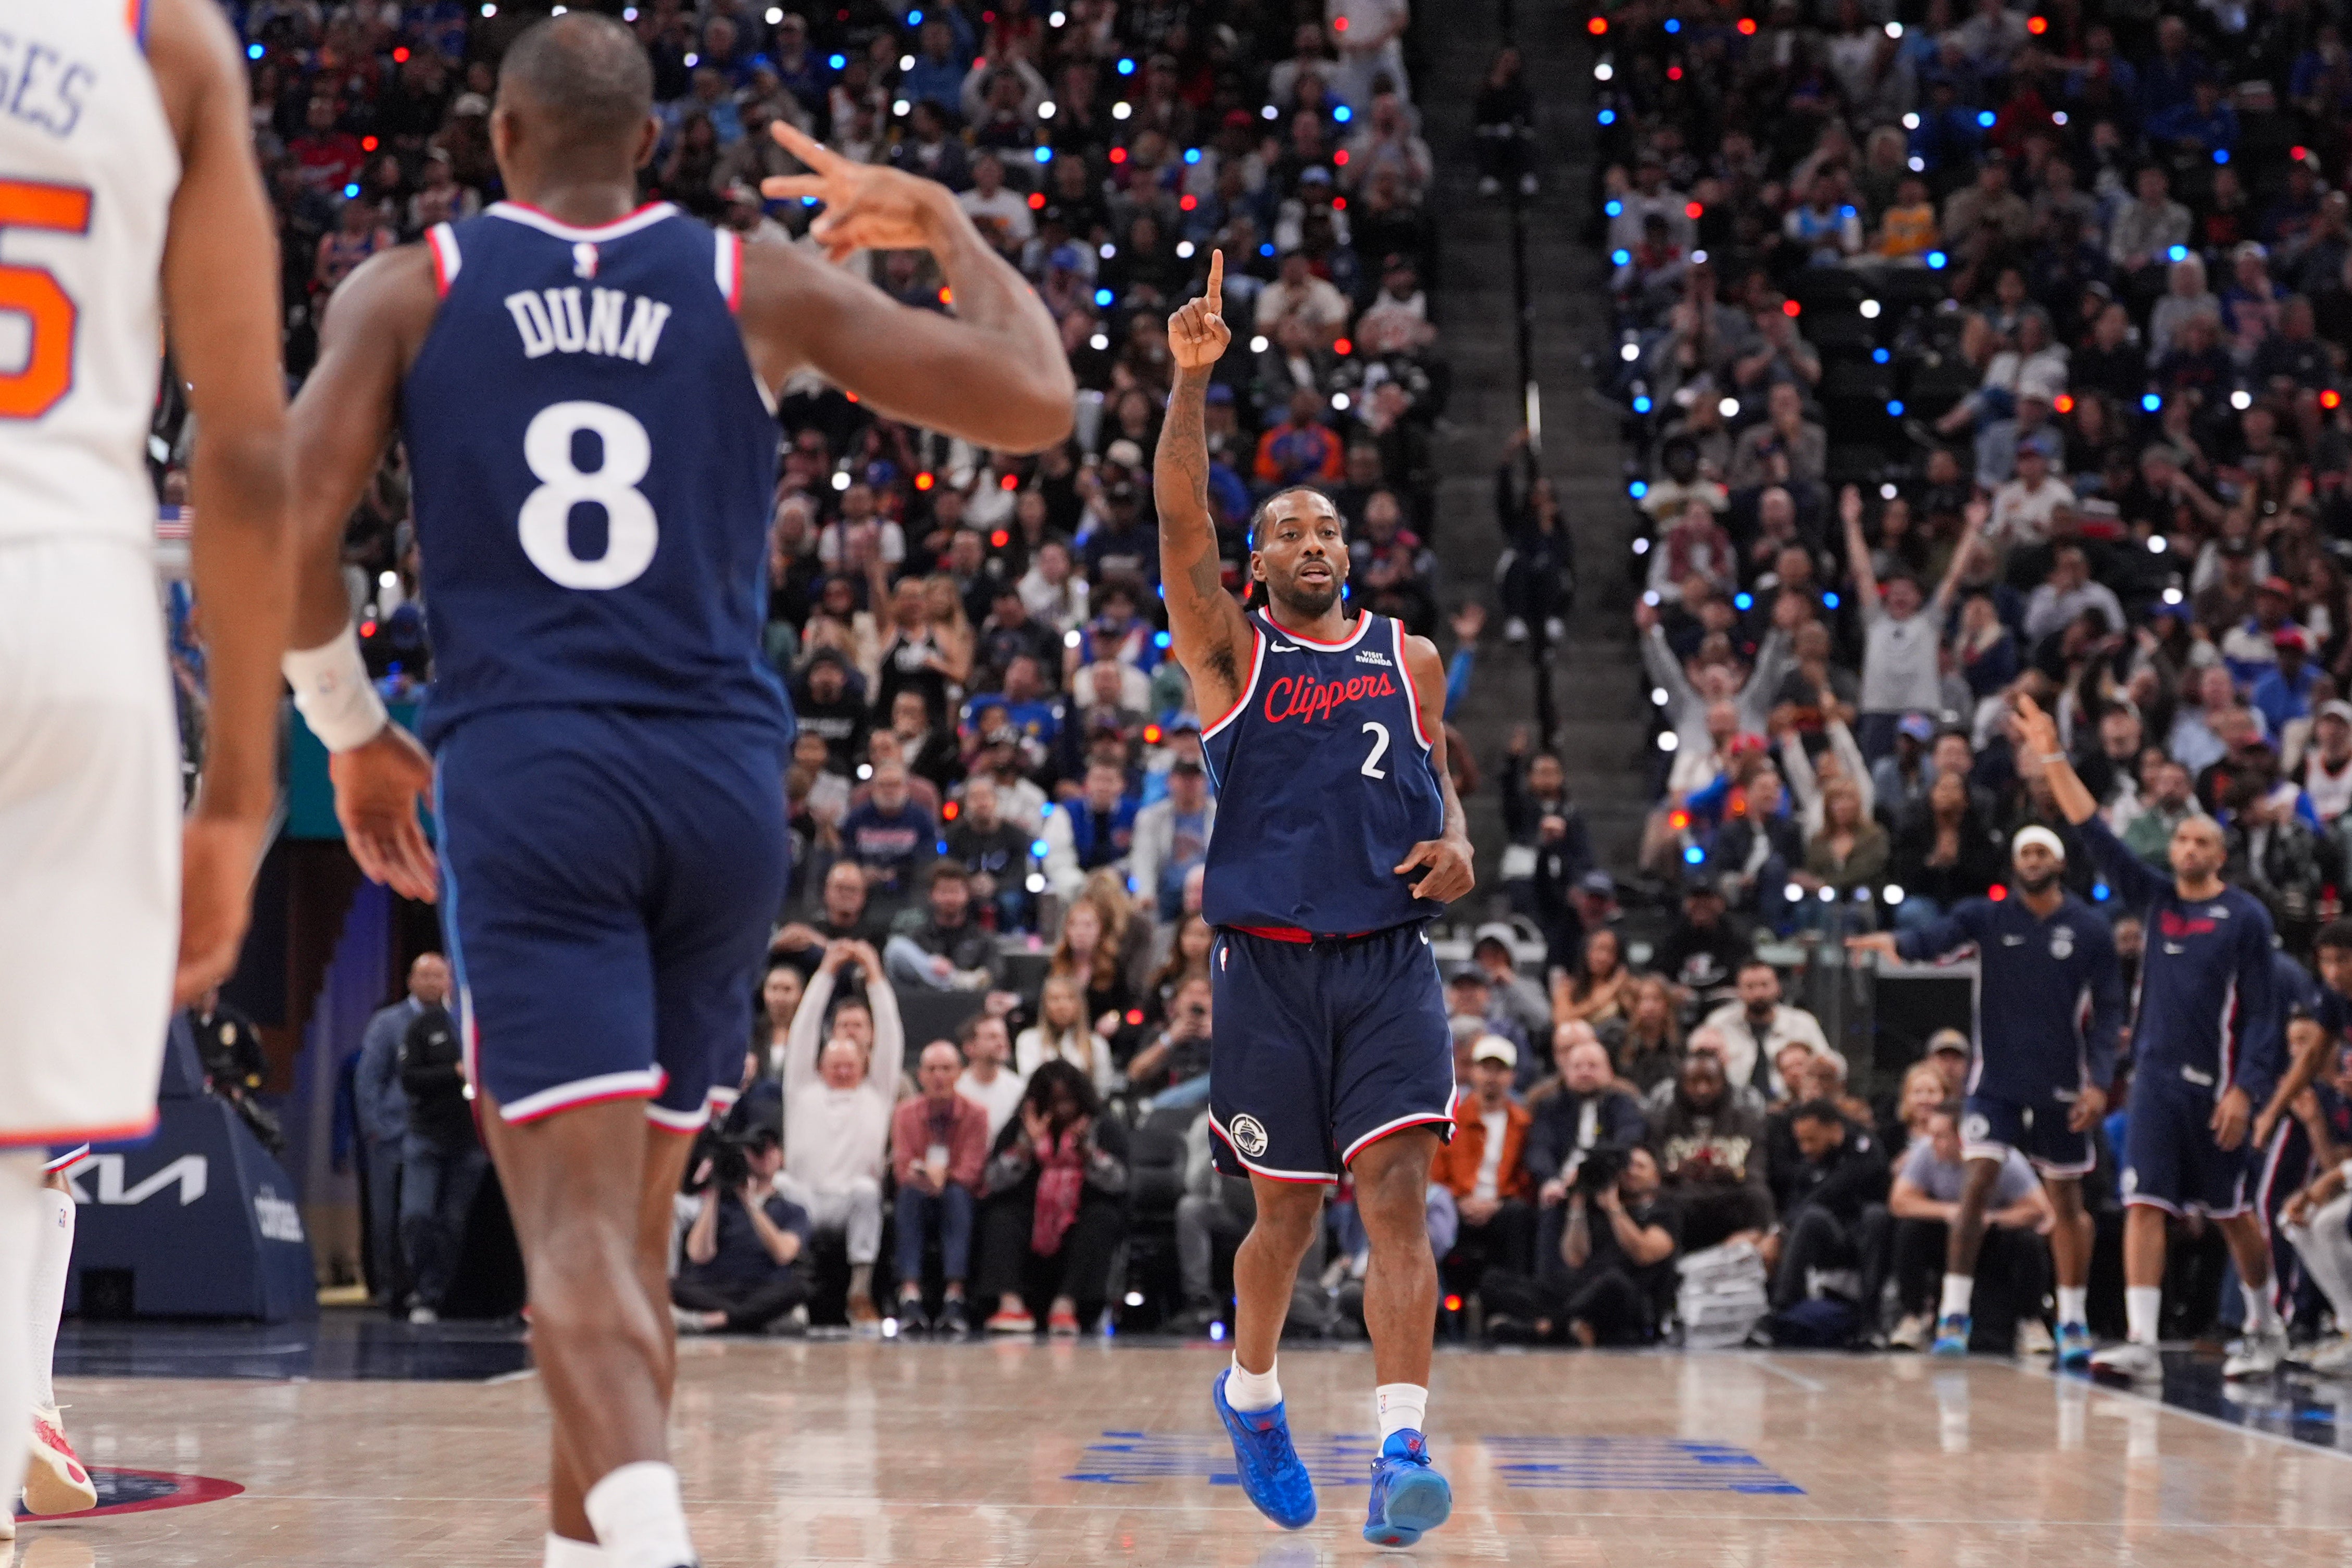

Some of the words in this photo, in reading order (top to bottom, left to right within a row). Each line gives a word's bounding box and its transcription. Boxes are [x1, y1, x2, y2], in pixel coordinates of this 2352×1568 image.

[0, 31, 99, 140] ES
[0, 178, 94, 423] 5
[504, 286, 672, 365] DUNN
[517, 400, 659, 590] 8
[1355, 655, 1393, 667] RWANDA
[1361, 650, 1383, 659] VISIT
[1264, 672, 1397, 724] Clippers
[1361, 721, 1390, 780] 2
